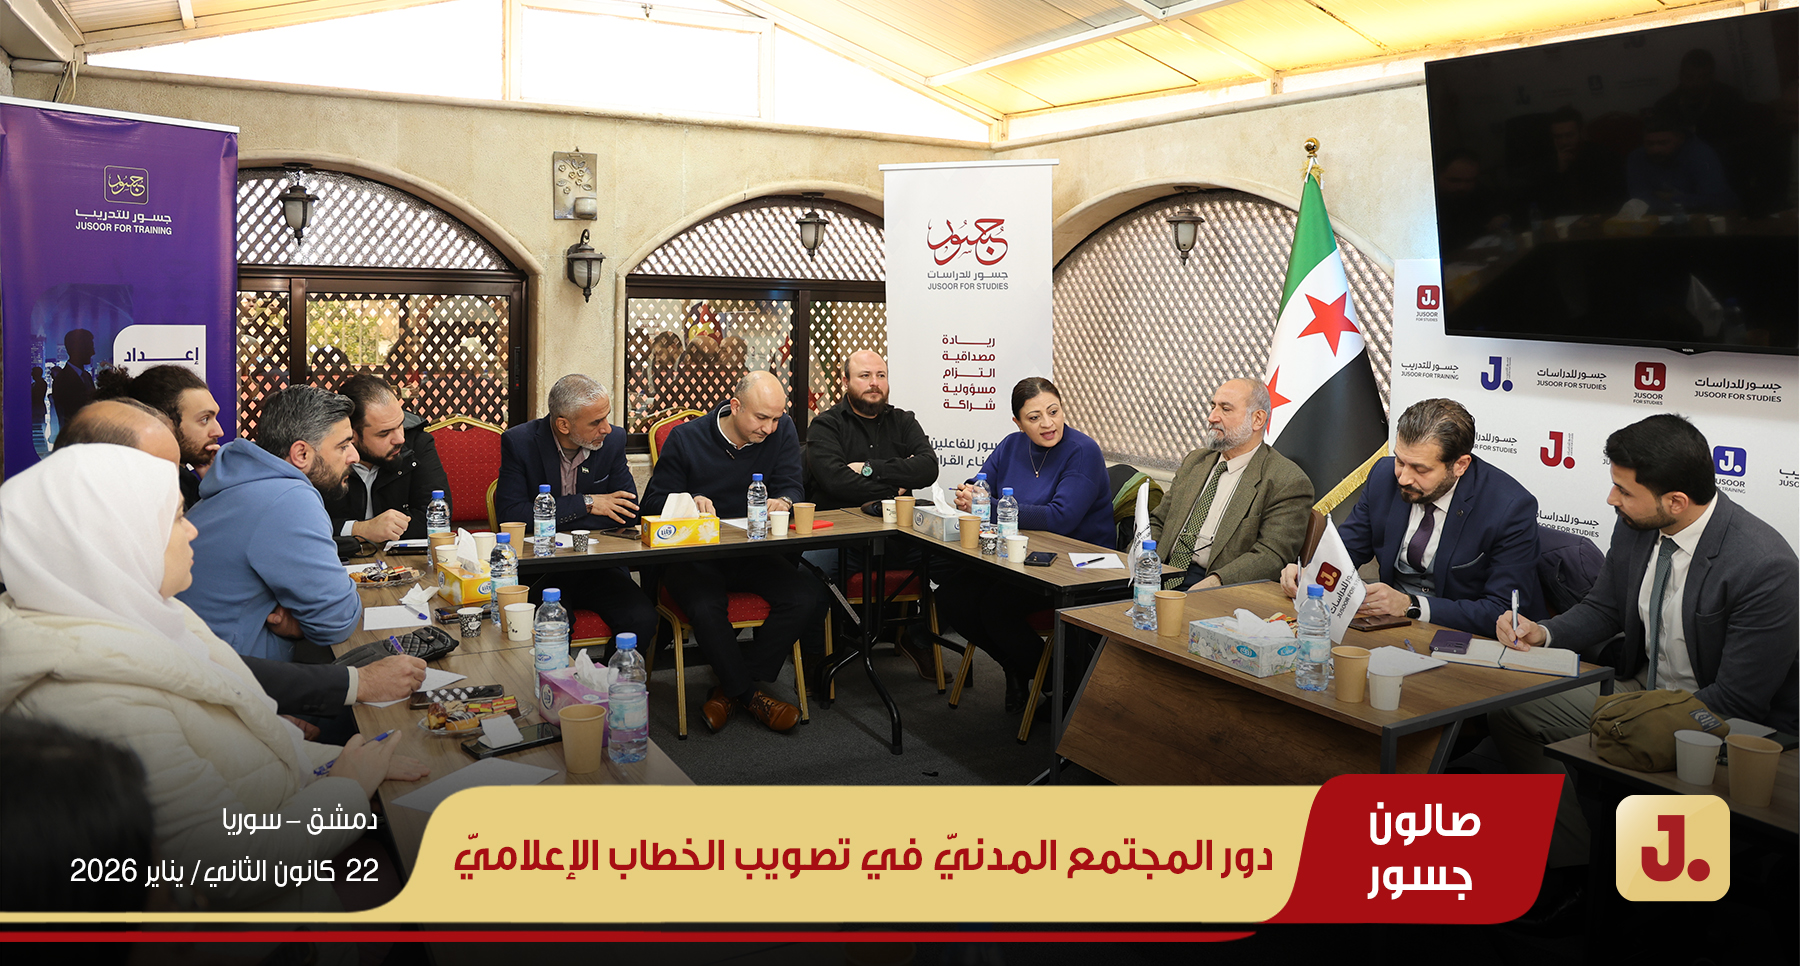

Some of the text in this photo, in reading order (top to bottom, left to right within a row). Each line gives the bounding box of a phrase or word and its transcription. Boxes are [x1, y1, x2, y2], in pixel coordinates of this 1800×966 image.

[75, 208, 172, 225] جسور للتدريب
[75, 221, 172, 235] JUSOOR FOR TRAINING
[927, 270, 1008, 281] جسور للدراسات
[927, 282, 1009, 290] JUSOOR FOR STUDIES
[942, 334, 995, 348] ريادة
[124, 347, 199, 365] إعداد
[942, 350, 996, 364] مصداقية
[942, 367, 996, 379] التزام
[1401, 360, 1459, 373] جسور للتدريب
[1537, 368, 1607, 382] جسور للدراسات
[942, 383, 996, 396] مسؤولية
[1537, 379, 1607, 390] JUSOOR FOR STUDIES
[1694, 377, 1782, 393] جسور للدراسات
[1633, 392, 1663, 400] JUSOOR
[1694, 390, 1782, 403] JUSOOR FOR STUDIES
[943, 398, 996, 412] شراكة
[1475, 432, 1518, 446] جسور للدرا
[1492, 446, 1518, 454] STUDIES
[937, 454, 964, 467] القرا
[1715, 479, 1746, 488] USOOR
[1570, 517, 1599, 529] جسور
[1571, 528, 1600, 537] STUDIES
